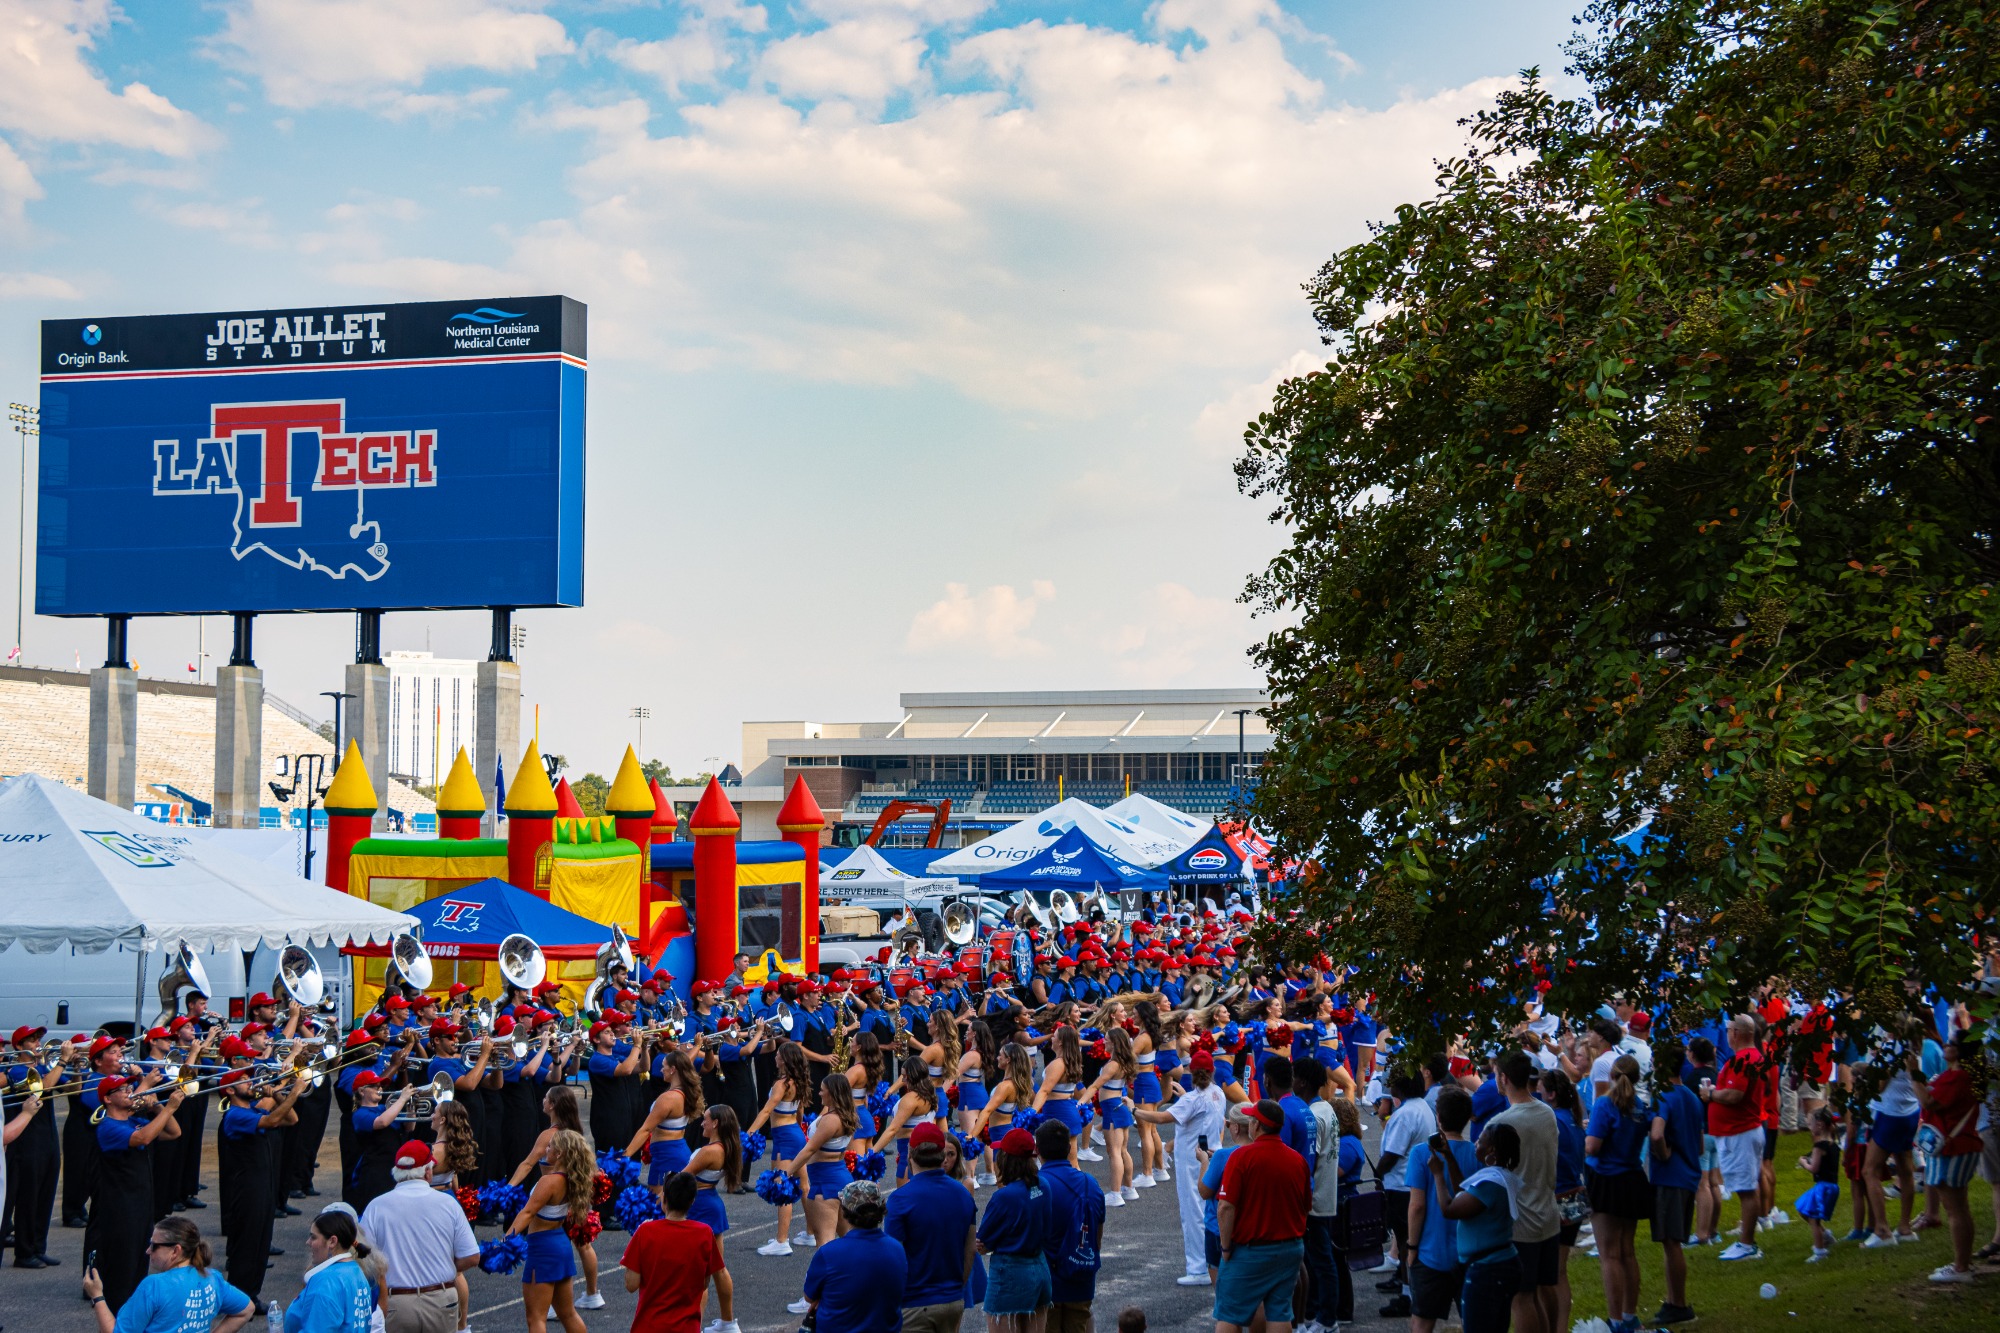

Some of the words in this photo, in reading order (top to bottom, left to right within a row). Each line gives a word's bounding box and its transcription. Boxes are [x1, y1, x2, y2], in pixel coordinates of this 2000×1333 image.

[207, 318, 265, 346] JOE
[271, 312, 386, 343] AILLET
[446, 324, 492, 337] Northern
[494, 322, 540, 335] Louisiana
[206, 339, 386, 361] STADIUM
[454, 336, 494, 349] Medical
[496, 336, 531, 347] Center
[58, 353, 95, 368] Origin
[1030, 866, 1055, 876] AIR
[832, 887, 863, 896] SERVE
[863, 888, 889, 896] HERE
